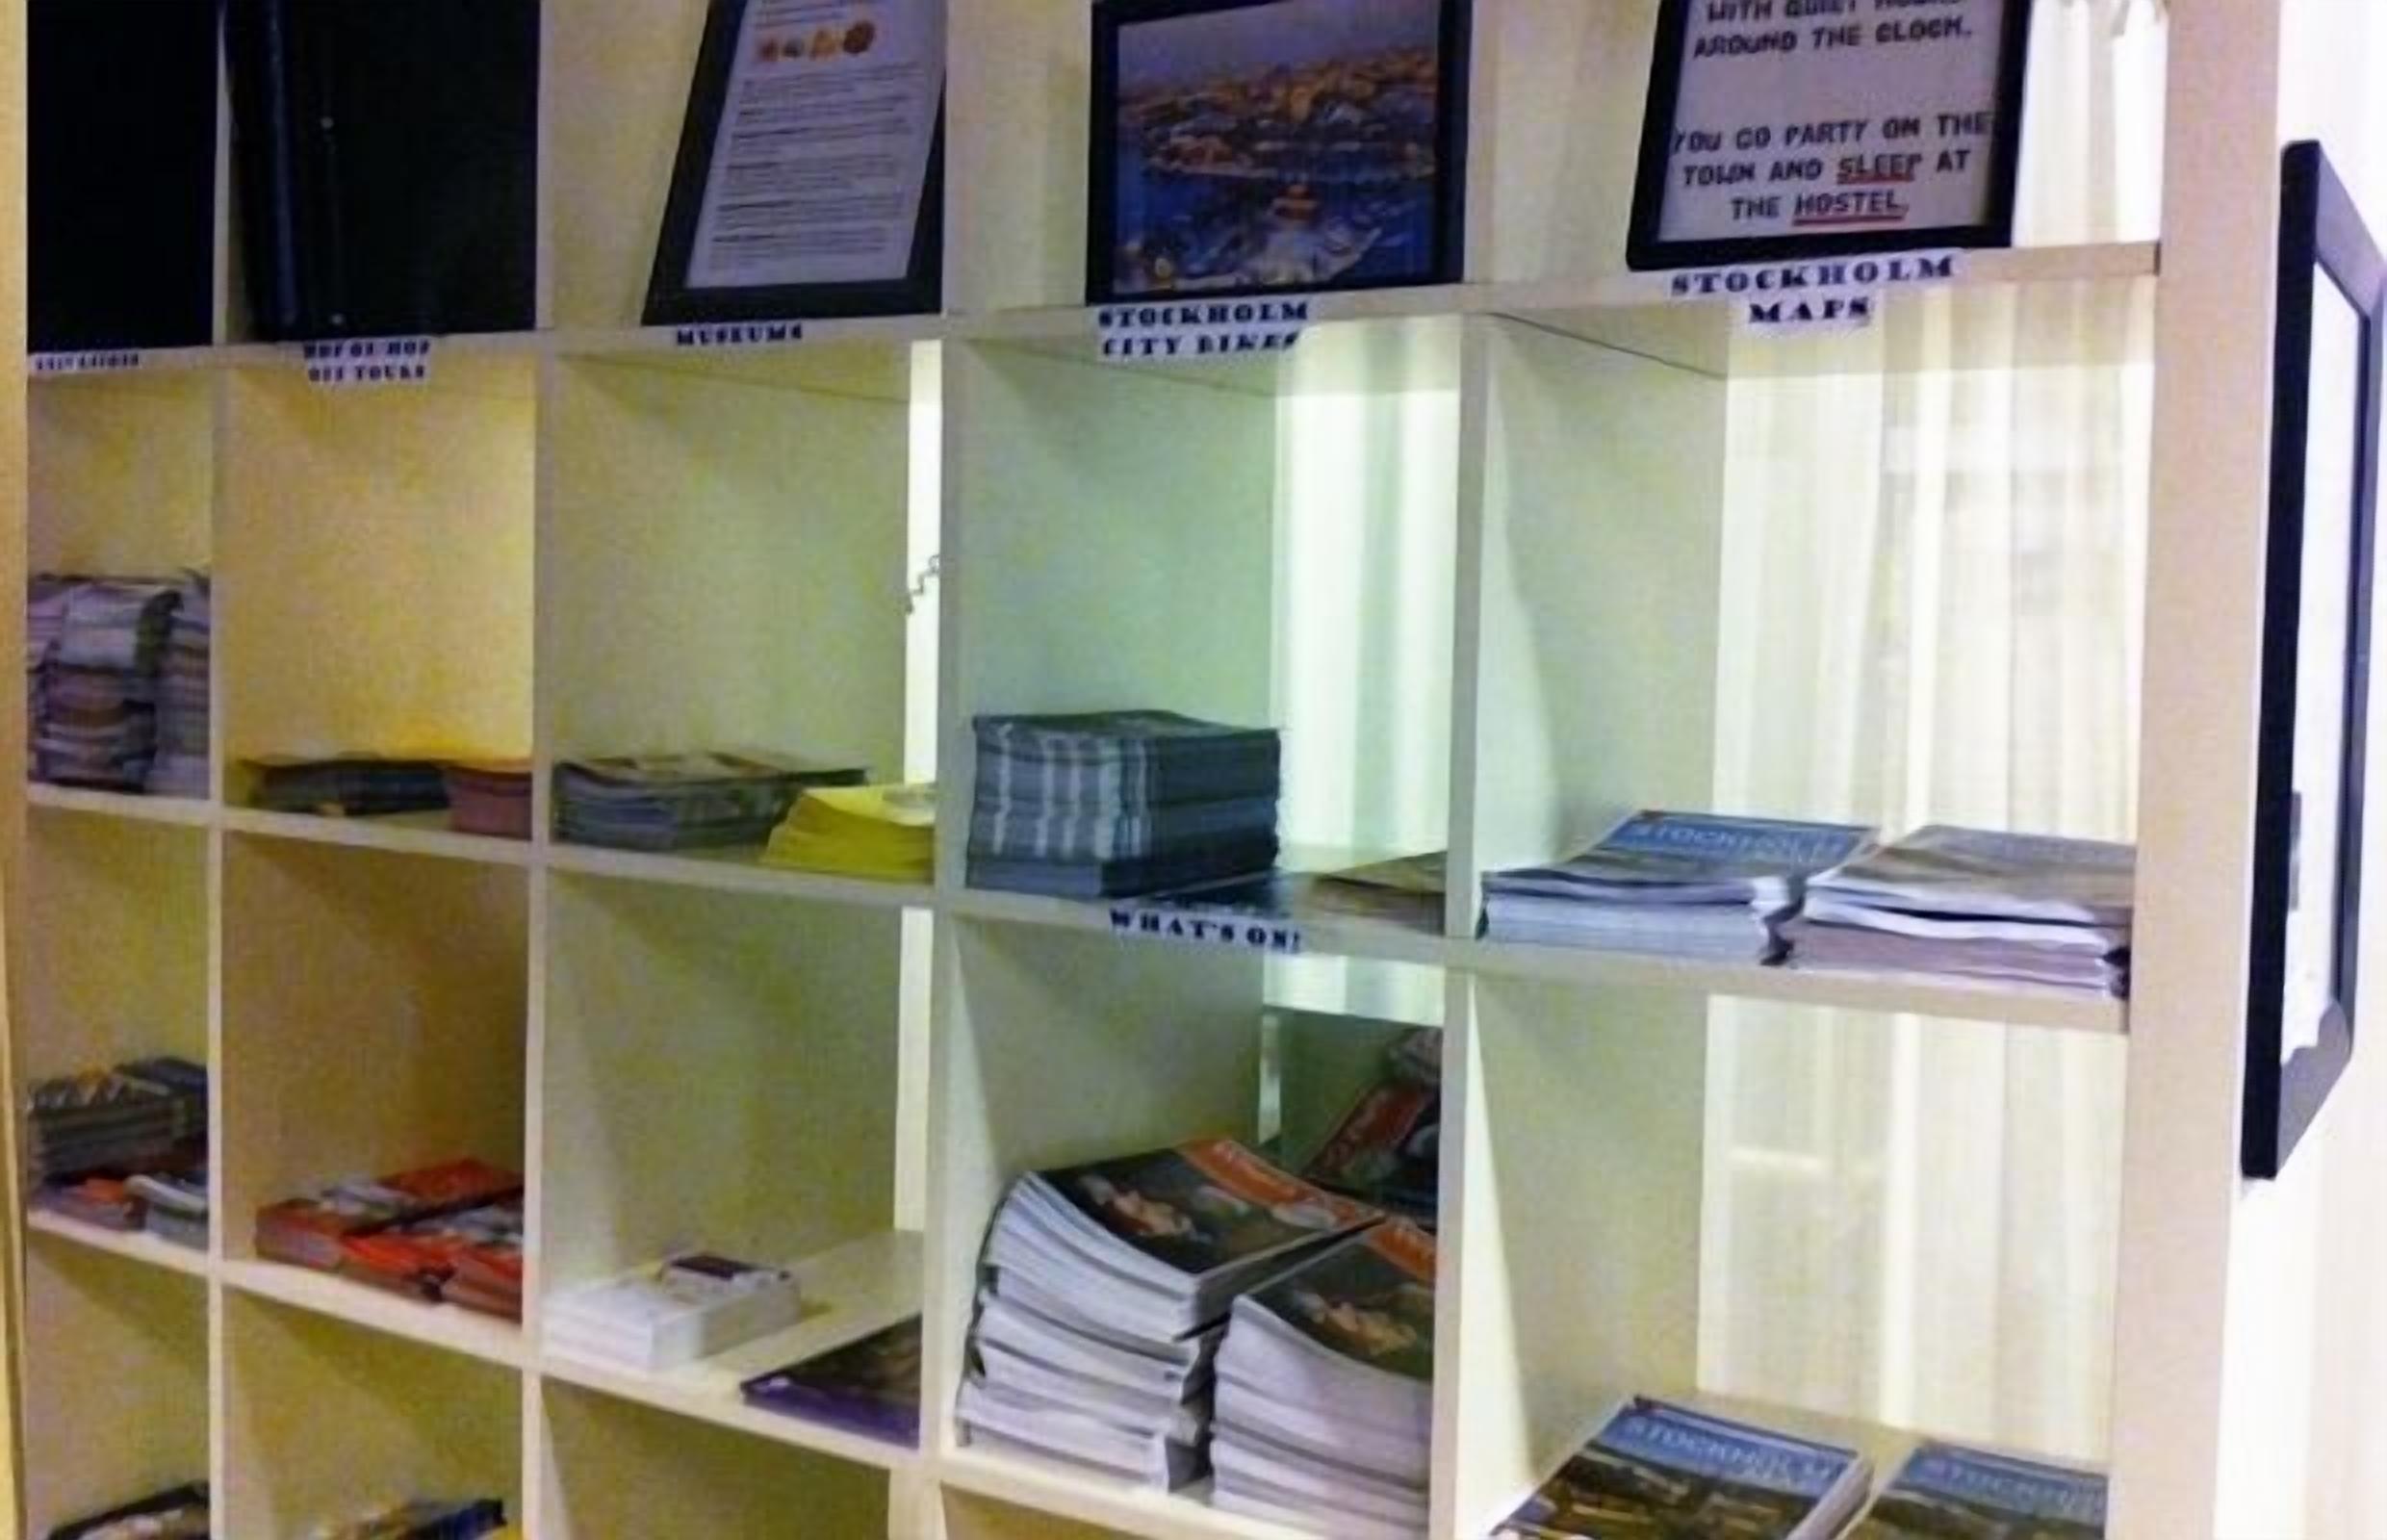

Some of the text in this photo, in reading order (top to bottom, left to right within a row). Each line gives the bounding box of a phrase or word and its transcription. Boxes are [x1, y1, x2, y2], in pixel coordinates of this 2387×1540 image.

[1693, 31, 1798, 58] AROUND
[1810, 24, 1862, 48] THE
[1673, 111, 1993, 154] YOU GO PARTY ON THE
[1683, 150, 1970, 186] TOWN AND SLEEP AT
[1731, 195, 1781, 220] THE
[1671, 255, 1953, 295] STOCKHOLM
[1098, 301, 1308, 328] STOCKHOLM
[1749, 296, 1869, 322] MAPS
[677, 323, 802, 345] MUSEUMS
[1103, 337, 1183, 355] CITY
[1109, 908, 1235, 942] WHAT'S
